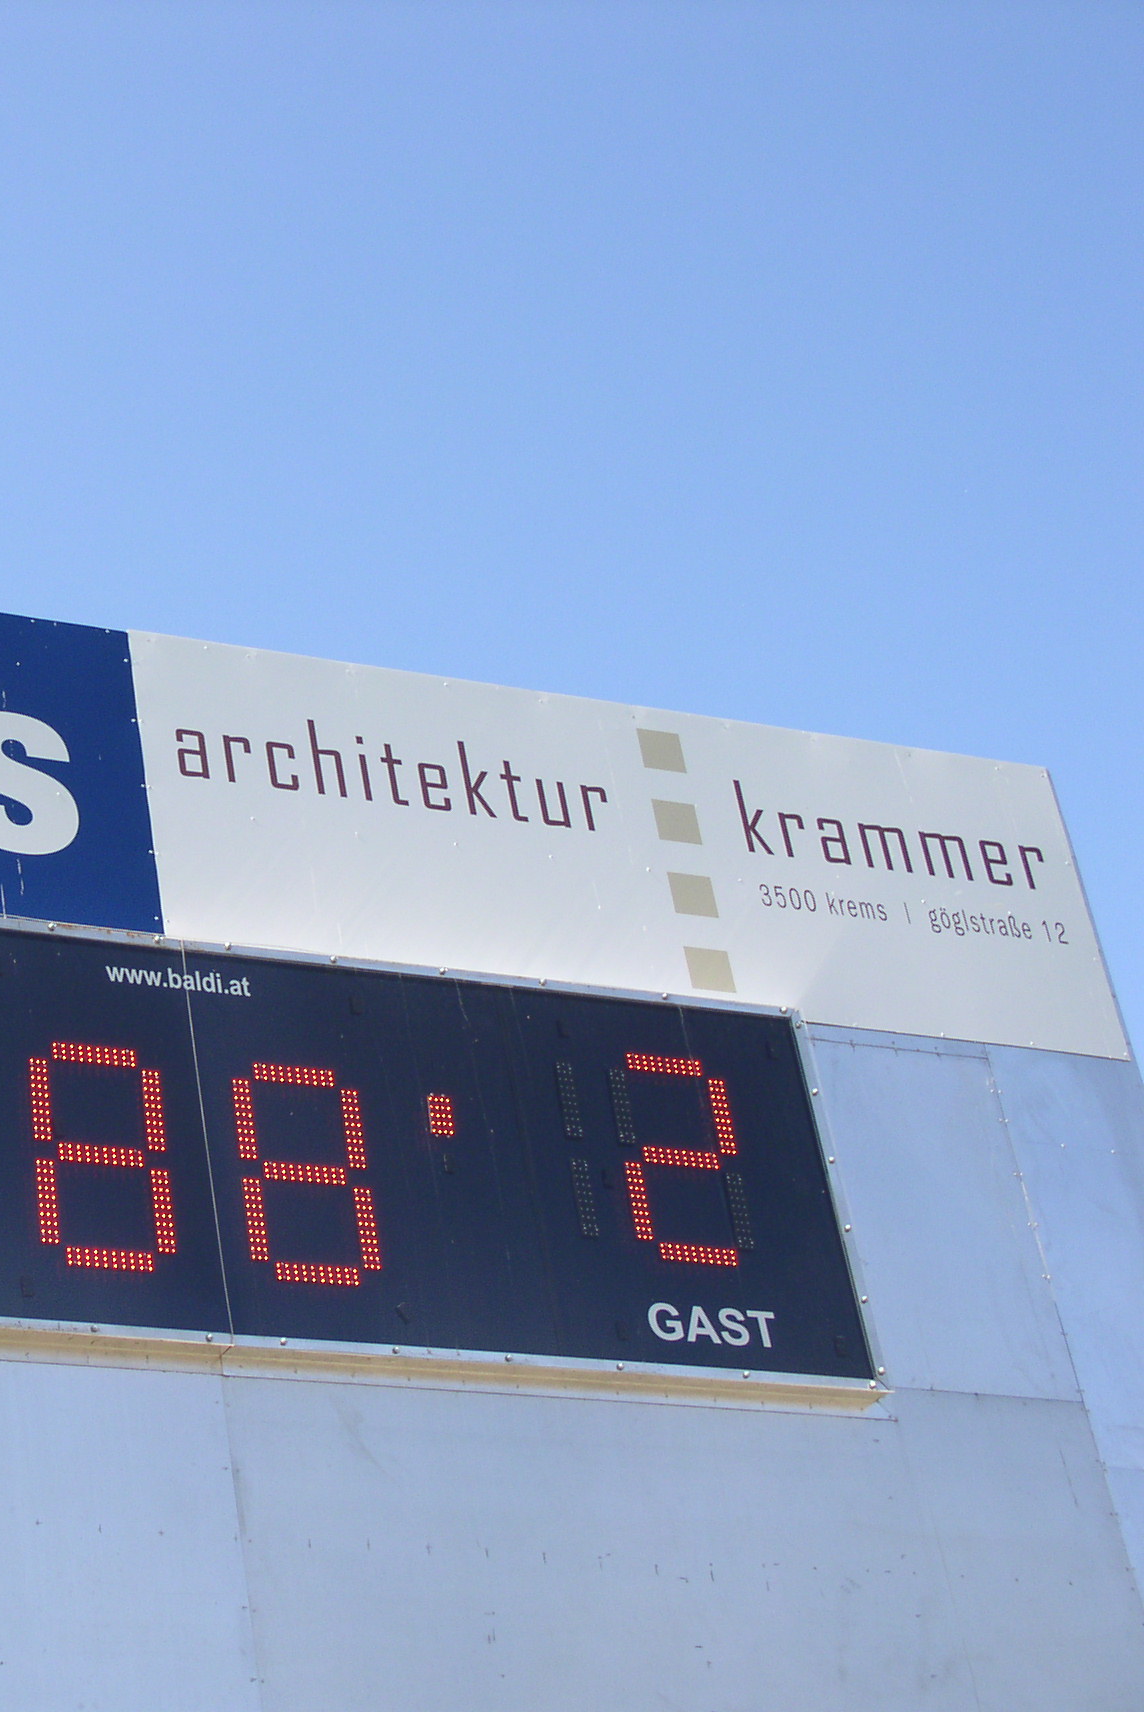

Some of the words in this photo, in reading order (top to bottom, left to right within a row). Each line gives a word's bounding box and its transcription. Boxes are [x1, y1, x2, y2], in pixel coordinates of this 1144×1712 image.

[175, 719, 608, 832] architektur
[732, 779, 1045, 890] krammer
[759, 883, 817, 913] 3500
[825, 891, 888, 922] krems
[928, 906, 1033, 940] göglstraße
[1042, 920, 1070, 945] 12
[105, 962, 252, 998] www.baldi.at
[624, 1052, 738, 1267] 2
[647, 1301, 776, 1349] GAST
